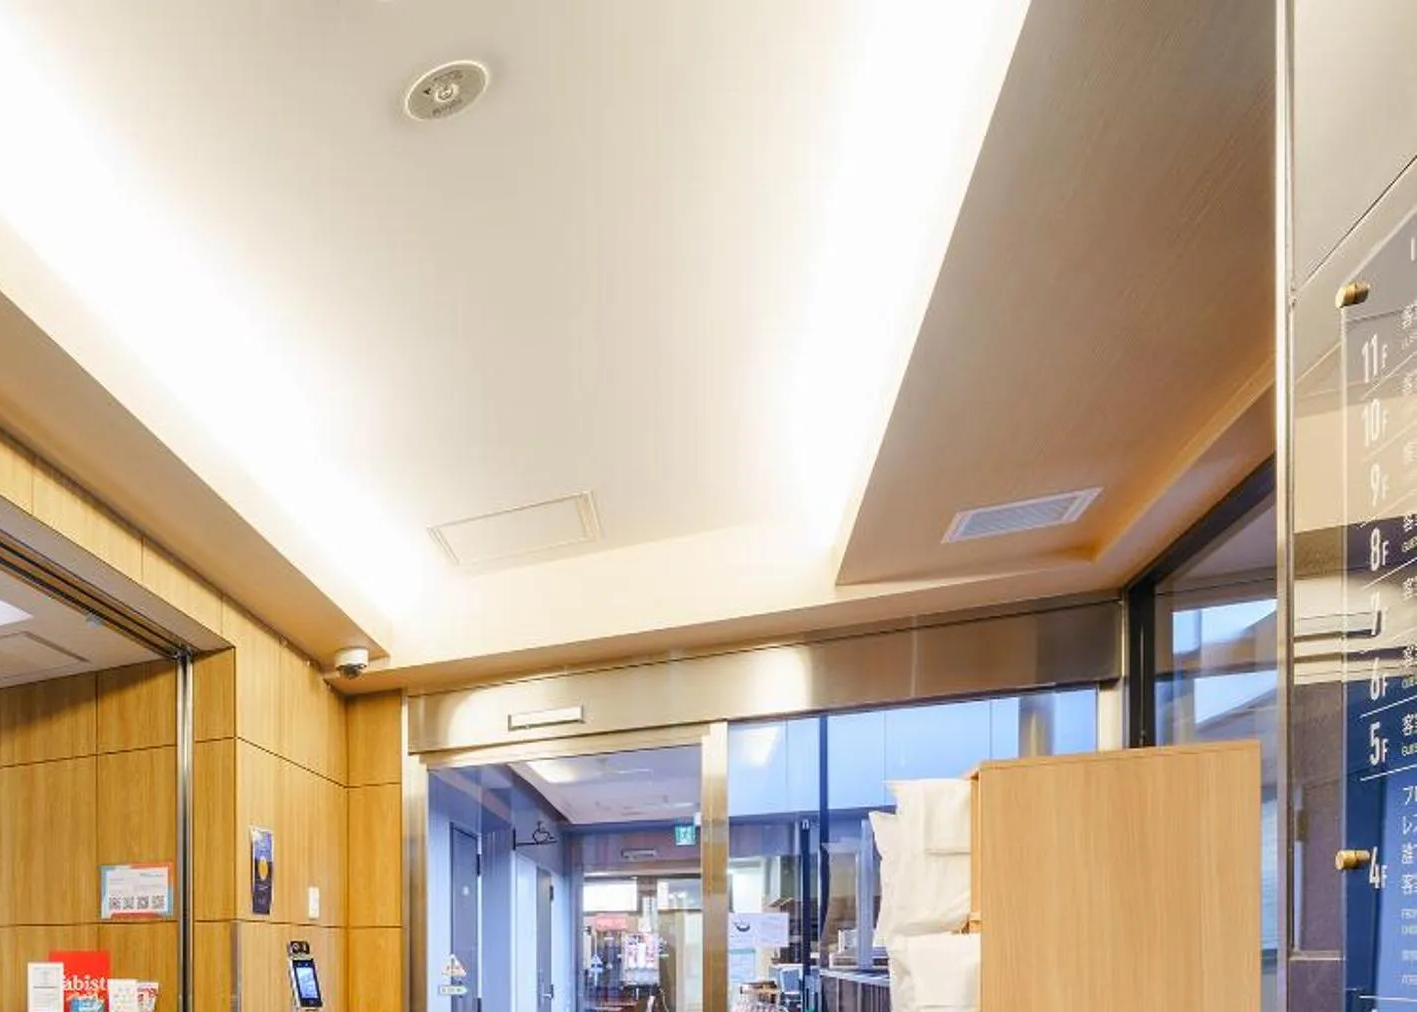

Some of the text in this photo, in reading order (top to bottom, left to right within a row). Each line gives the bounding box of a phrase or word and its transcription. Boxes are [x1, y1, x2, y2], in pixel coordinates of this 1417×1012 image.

[1362, 333, 1387, 384] 11F
[1362, 398, 1388, 447] 10F
[1371, 464, 1388, 506] 9F
[1371, 527, 1389, 571] 8F
[1370, 657, 1388, 700] 6F
[1370, 722, 1388, 767] 5F
[1369, 846, 1387, 889] 4F
